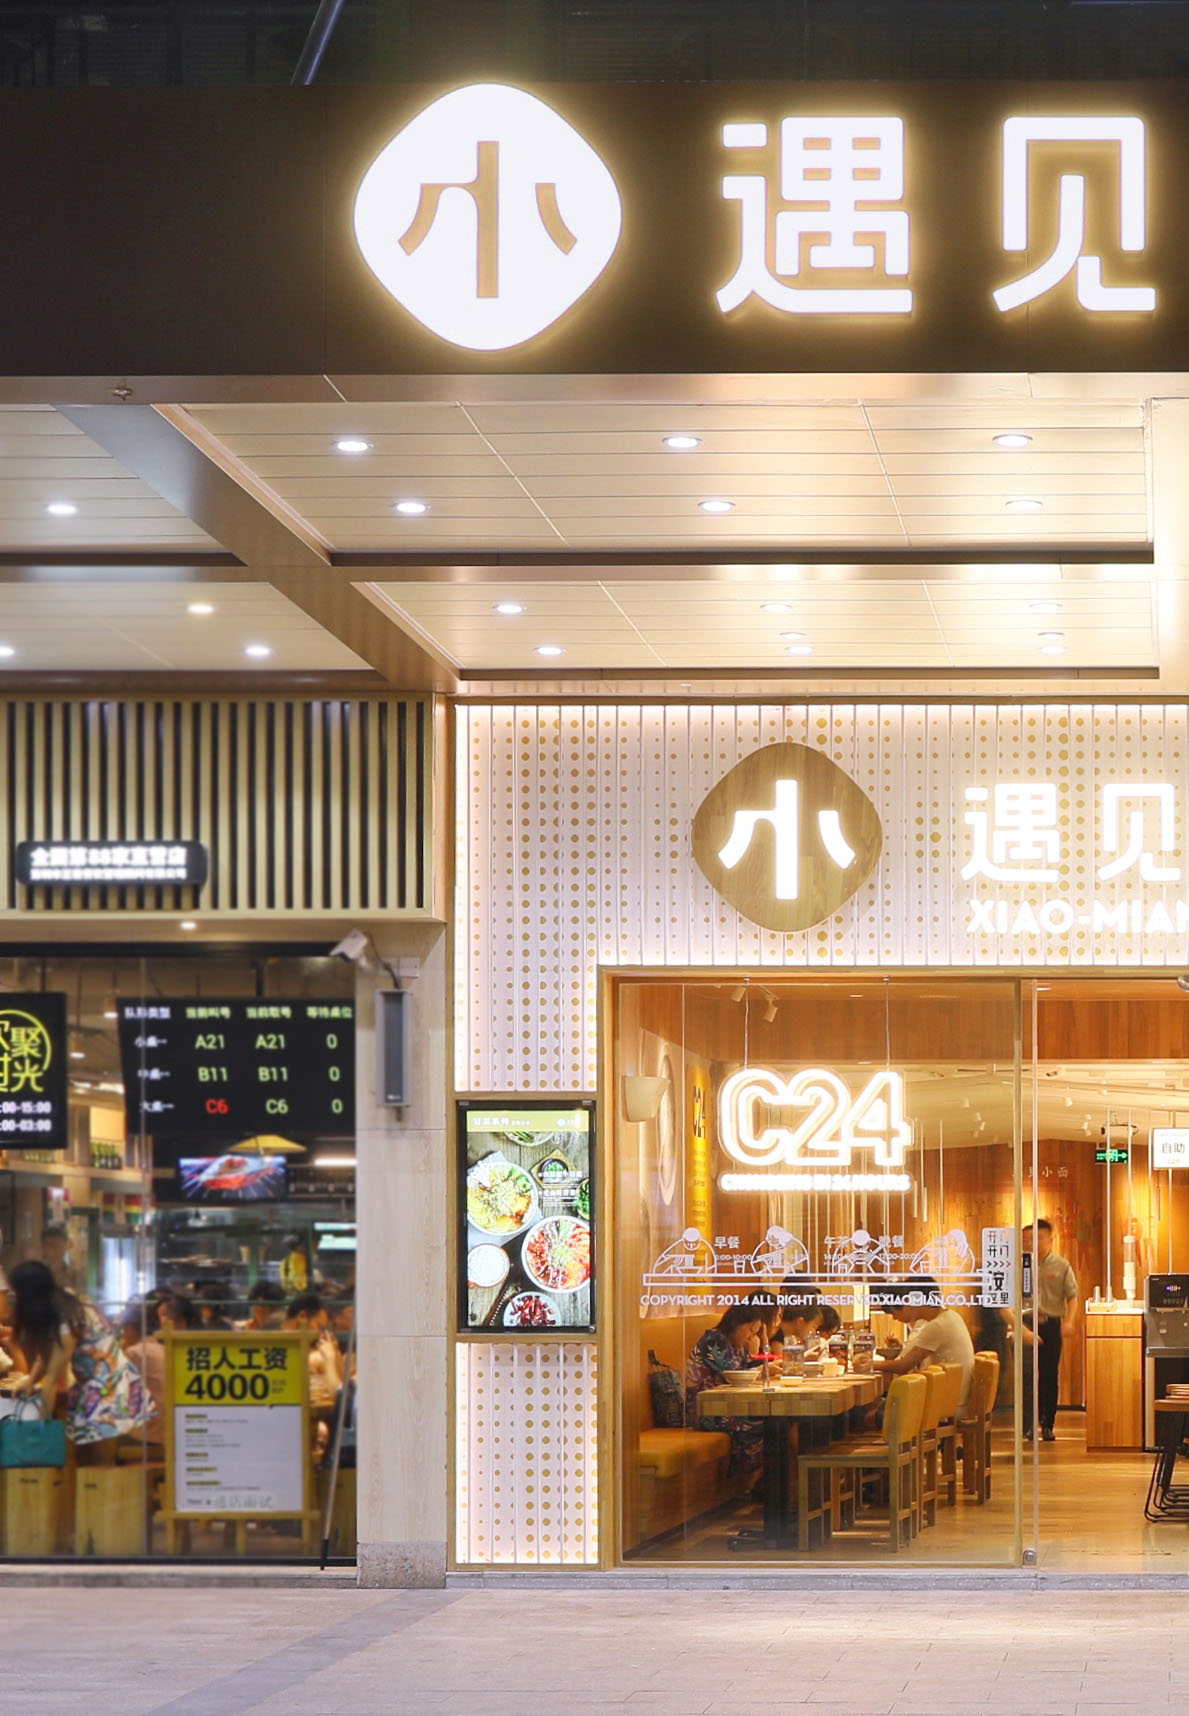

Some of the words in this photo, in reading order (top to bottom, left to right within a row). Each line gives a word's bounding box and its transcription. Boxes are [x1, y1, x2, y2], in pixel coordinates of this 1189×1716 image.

[398, 140, 578, 299] 小
[717, 779, 856, 900] 小
[195, 1034, 225, 1049] A21
[255, 1034, 286, 1049] A21
[198, 1066, 228, 1082] B11
[258, 1066, 288, 1082] B11
[205, 1098, 229, 1114] C6
[265, 1098, 289, 1114] C6
[718, 1067, 913, 1167] C24
[713, 1236, 740, 1249] 早餐
[640, 1294, 715, 1306] COPYRIGHT
[717, 1294, 750, 1306] 2014
[751, 1294, 775, 1306] ALL
[777, 1294, 815, 1306] RIGHT
[186, 1346, 288, 1371] 招人工资
[185, 1373, 269, 1400] 4000
